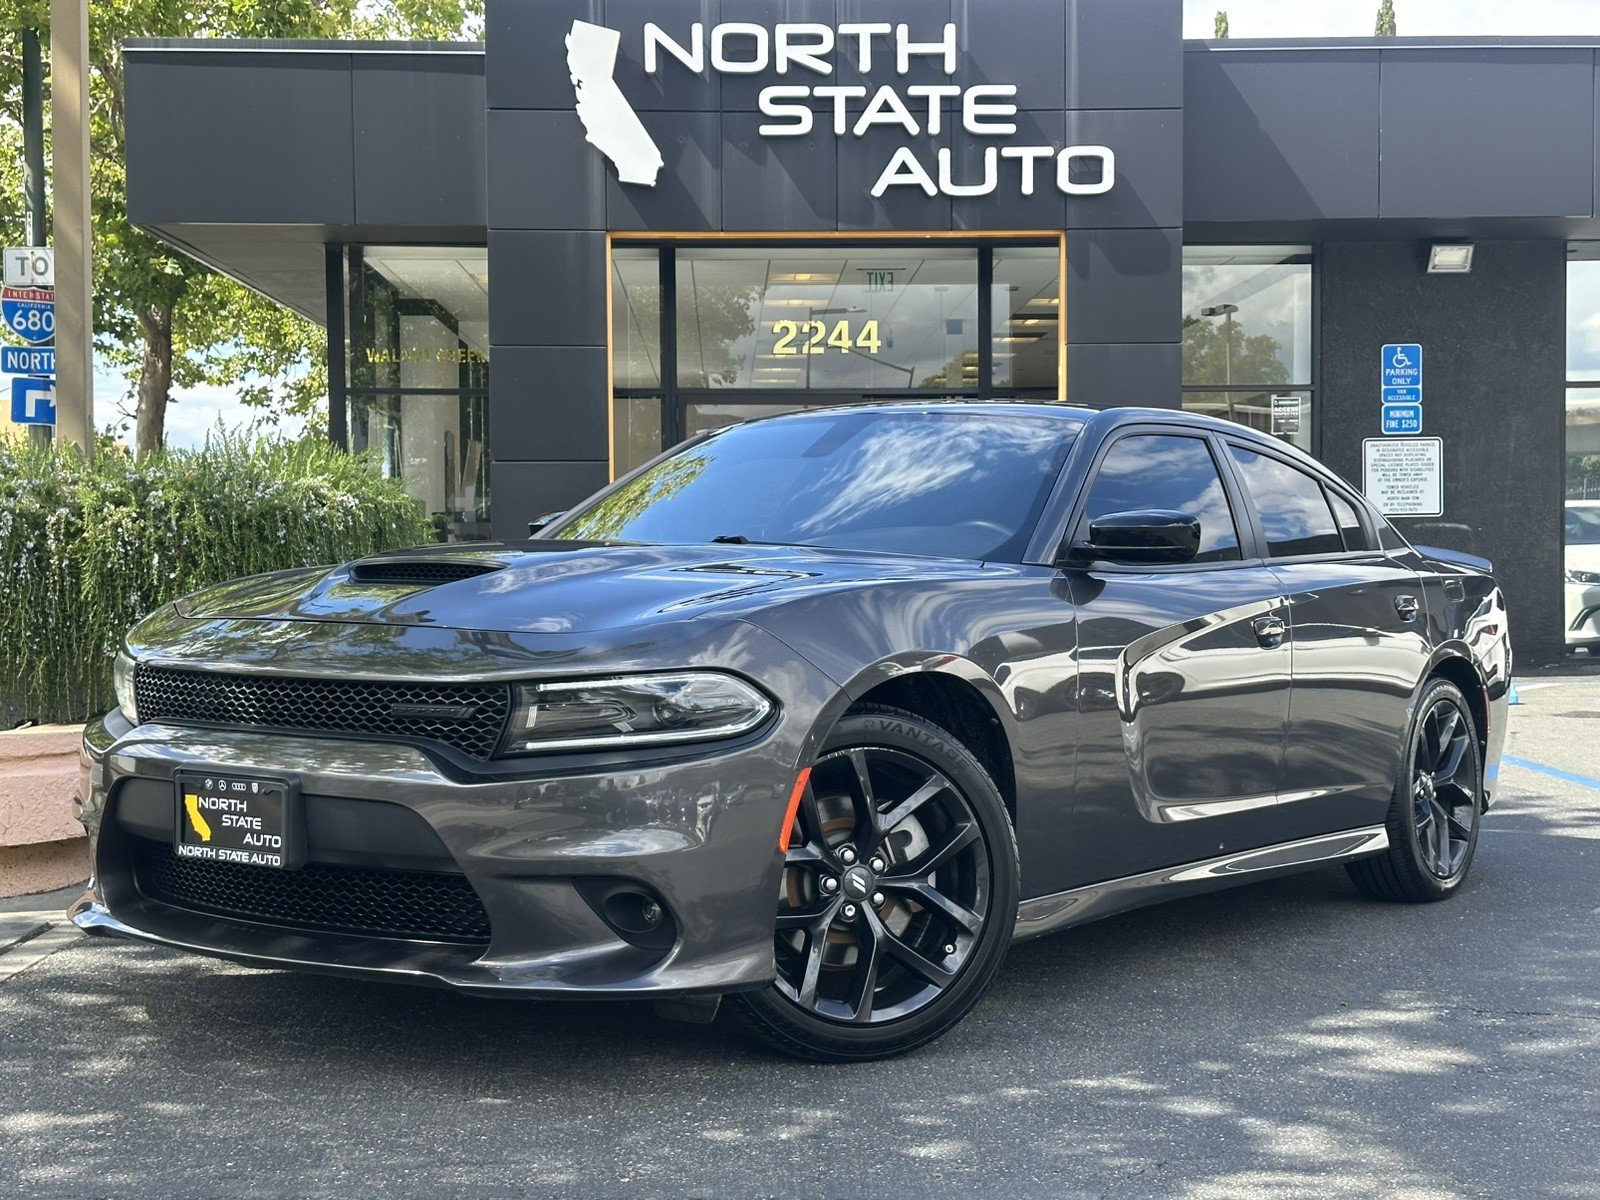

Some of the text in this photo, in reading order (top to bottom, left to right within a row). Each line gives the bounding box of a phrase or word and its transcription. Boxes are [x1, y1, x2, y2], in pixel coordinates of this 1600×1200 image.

[643, 22, 957, 75] NORTH
[758, 84, 1018, 137] STATE
[870, 145, 1116, 197] AUTO
[15, 256, 49, 276] TO
[8, 290, 54, 301] INTERSTAT
[13, 309, 54, 332] 680
[772, 320, 882, 355] 2244
[1385, 368, 1418, 376] PARKING
[1391, 377, 1412, 385] ONLY
[1386, 419, 1418, 429] FINE $250
[198, 797, 247, 812] NORTH
[221, 814, 262, 829] STATE
[243, 832, 281, 848] AUTO
[178, 845, 281, 866] NORTH STATE AUTO
